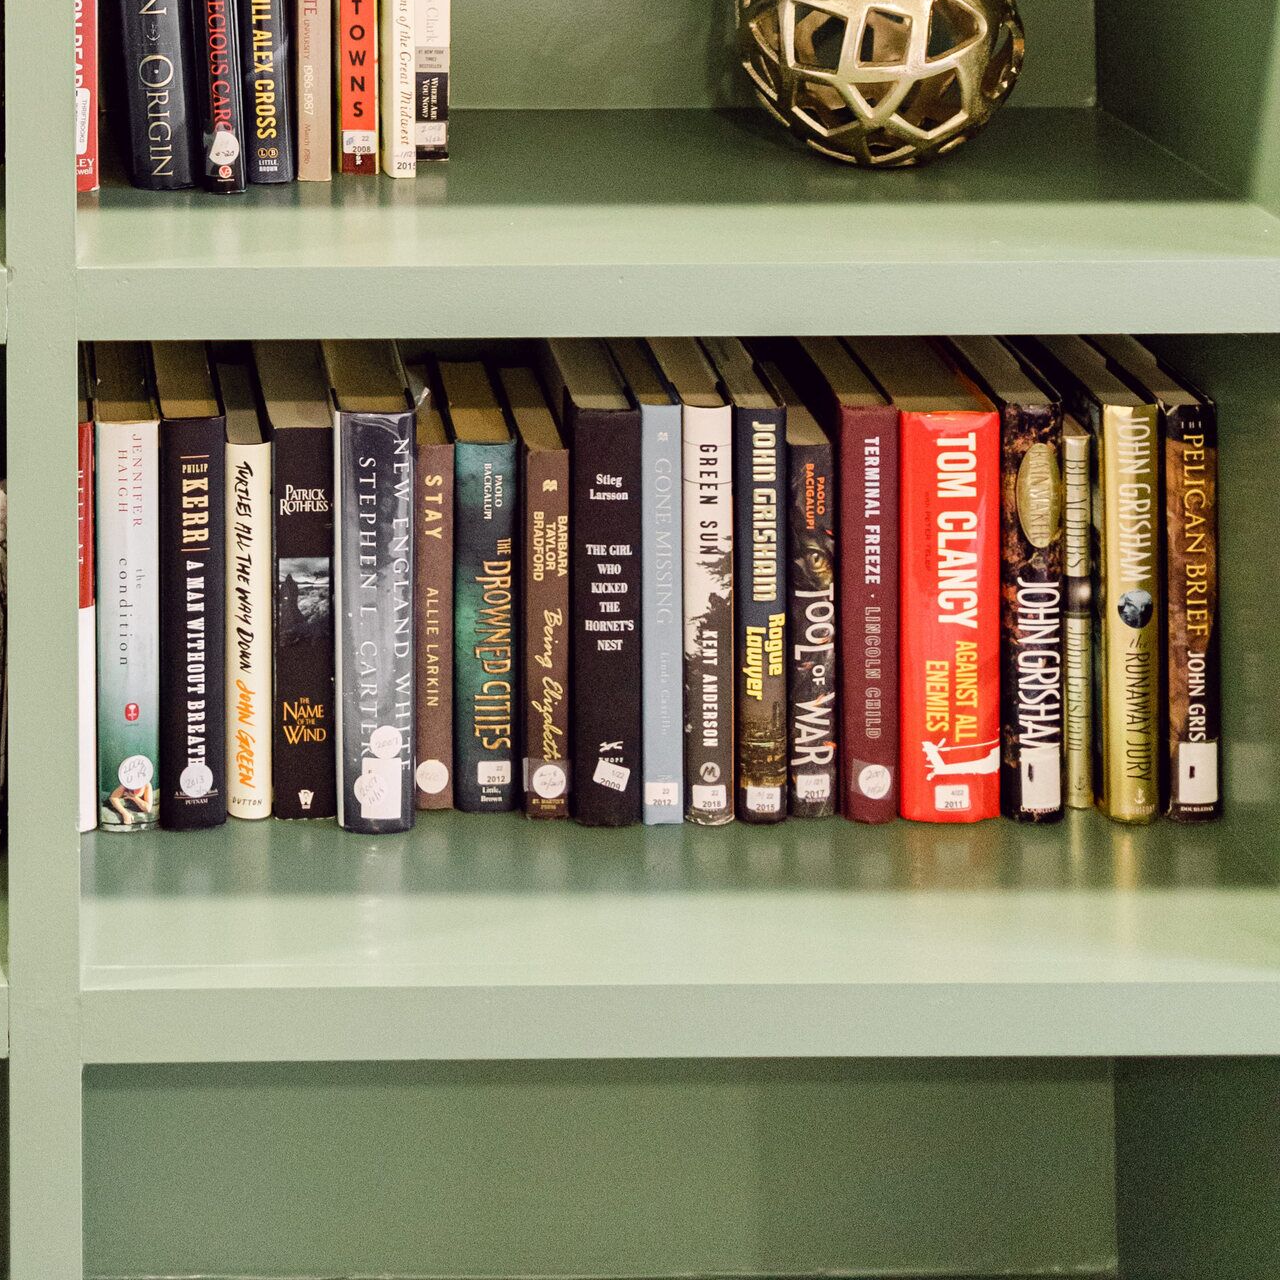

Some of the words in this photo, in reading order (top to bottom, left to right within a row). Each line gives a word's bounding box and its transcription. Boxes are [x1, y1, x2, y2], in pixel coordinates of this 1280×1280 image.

[138, 53, 175, 178] ORIGIN
[352, 145, 371, 153] 2008
[182, 464, 209, 474] PHILIP
[596, 474, 623, 488] Stieg
[284, 484, 326, 502] PATRICK
[589, 489, 629, 501] Larsson
[181, 476, 210, 543] KERR
[279, 500, 329, 515] ROTHFUSS
[424, 475, 443, 542] STAY
[586, 545, 608, 556] THE
[610, 545, 633, 556] GIRL
[597, 564, 621, 575] WHO
[591, 583, 628, 594] KICKED
[599, 602, 620, 612] THE
[585, 620, 635, 632] HORNET'S
[597, 640, 624, 651] NEST
[701, 629, 719, 663] KENT
[954, 640, 978, 700] AGAINST
[924, 659, 950, 733] ENEMIES
[701, 667, 719, 747] ANDERSON
[954, 703, 978, 743] ALL
